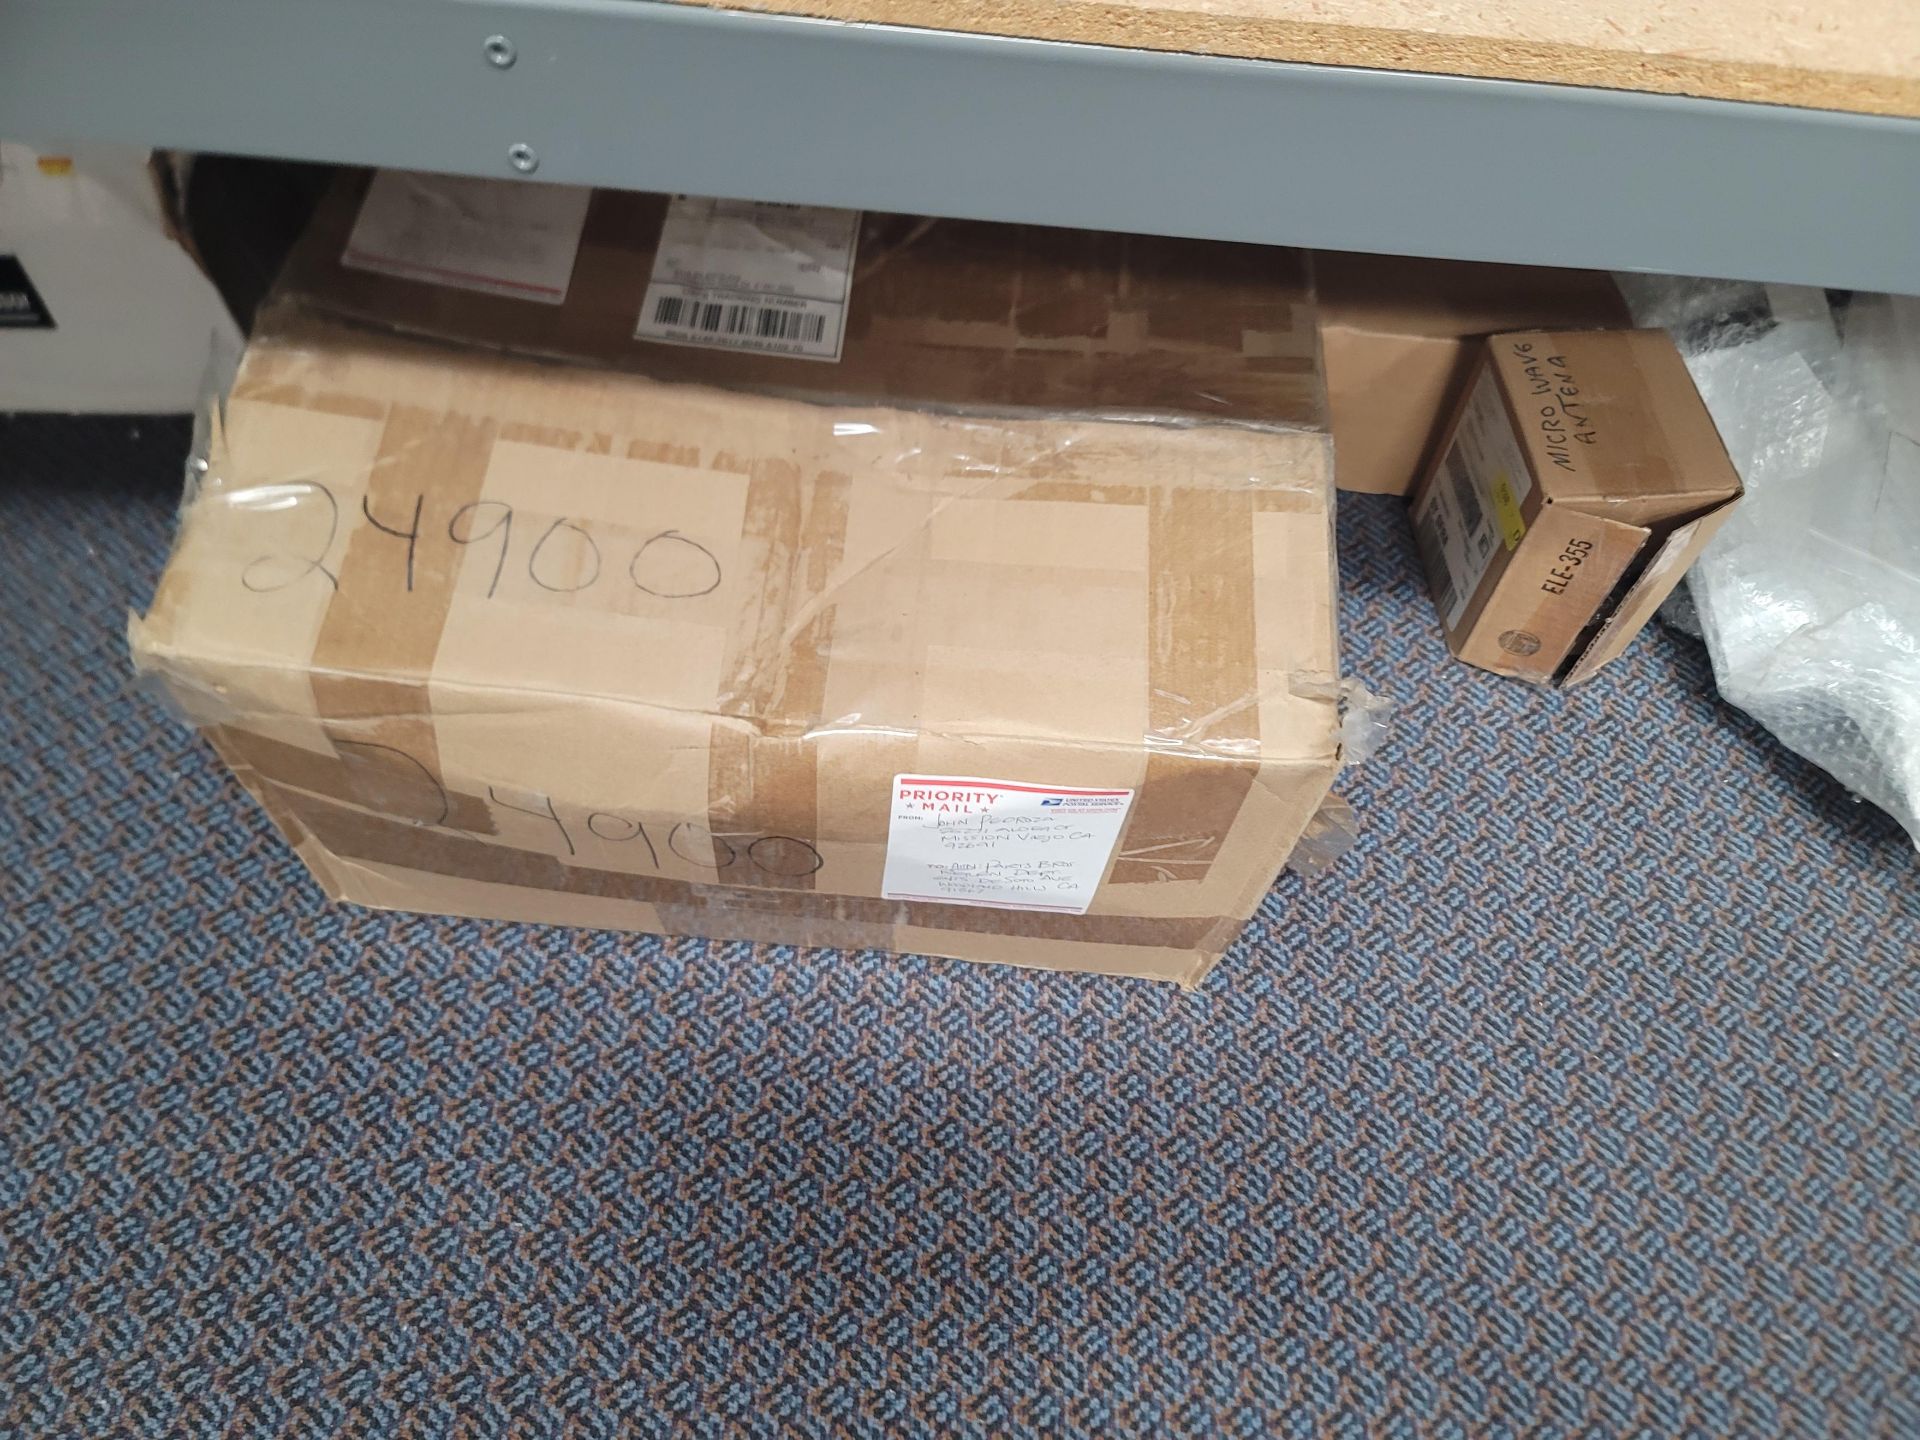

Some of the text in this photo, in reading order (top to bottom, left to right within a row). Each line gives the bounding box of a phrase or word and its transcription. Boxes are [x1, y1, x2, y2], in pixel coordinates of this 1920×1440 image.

[1546, 354, 1598, 446] ANTENA
[1541, 405, 1577, 473] MICRO
[240, 478, 722, 599] 24900
[1540, 537, 1594, 597] ELE-355
[900, 789, 1000, 804] PRIORITY
[922, 802, 973, 814] MAIL
